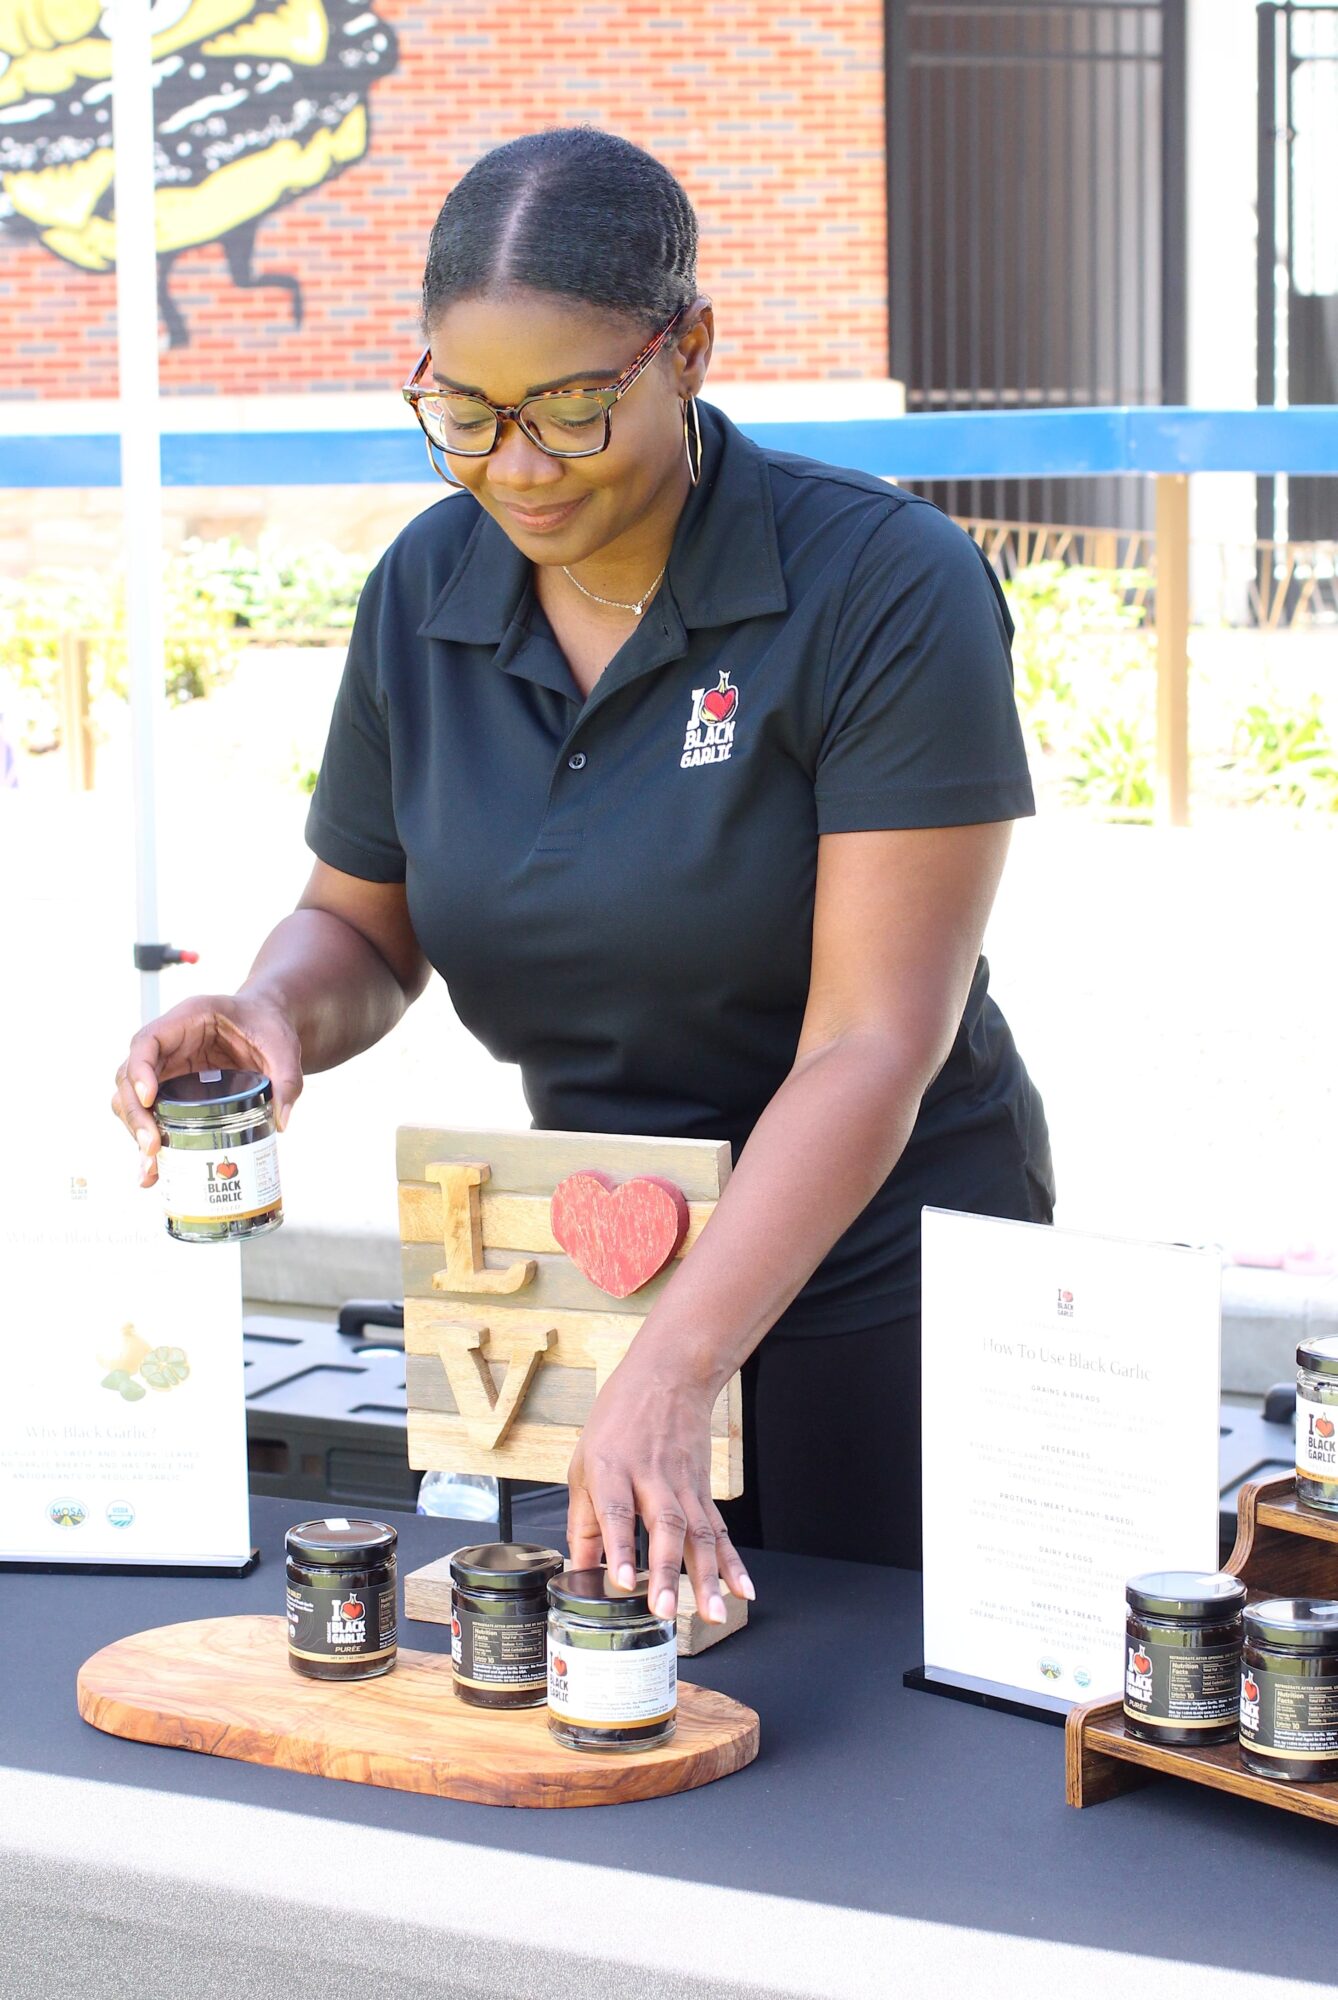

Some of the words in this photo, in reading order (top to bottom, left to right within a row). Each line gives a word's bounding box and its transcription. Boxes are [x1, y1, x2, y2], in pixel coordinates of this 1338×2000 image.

[687, 688, 705, 730] I
[683, 721, 736, 750] BLACK
[680, 742, 733, 768] GARLIC
[206, 1162, 216, 1181] I
[208, 1180, 241, 1193] BLACK
[209, 1192, 242, 1204] GARLIC
[1057, 1302, 1074, 1310] BLACK
[983, 1336, 1013, 1356] How
[1016, 1343, 1036, 1360] To
[1039, 1347, 1065, 1366] Use
[1068, 1352, 1106, 1374] Black
[1109, 1359, 1152, 1382] Garlic
[1031, 1384, 1060, 1397] GRAINS
[1070, 1392, 1101, 1403] BREADS
[1308, 1413, 1314, 1435] I
[64, 1425, 102, 1439] Black
[107, 1425, 157, 1439] Garlic?
[1040, 1444, 1091, 1460] VEGETABLES
[1308, 1437, 1336, 1453] BLACK
[1308, 1449, 1336, 1464] GARLIC
[999, 1492, 1037, 1506] PROTEINS
[52, 1507, 84, 1517] MOSA
[1038, 1546, 1062, 1557] DAIRY
[1072, 1553, 1094, 1563] EGGS
[331, 1599, 341, 1622] I
[1031, 1600, 1062, 1614] SWEETS
[1072, 1610, 1102, 1622] TREATS
[331, 1620, 365, 1633] BLACK
[474, 1628, 497, 1636] Nutrition
[331, 1632, 366, 1644] GARLIC
[334, 1645, 362, 1653] PURÉE
[1172, 1662, 1199, 1670] Nutrition
[549, 1673, 569, 1691] BLACK
[1126, 1669, 1153, 1691] BLACK
[1277, 1691, 1304, 1699] Nutrition
[1128, 1699, 1148, 1712] PURÉE
